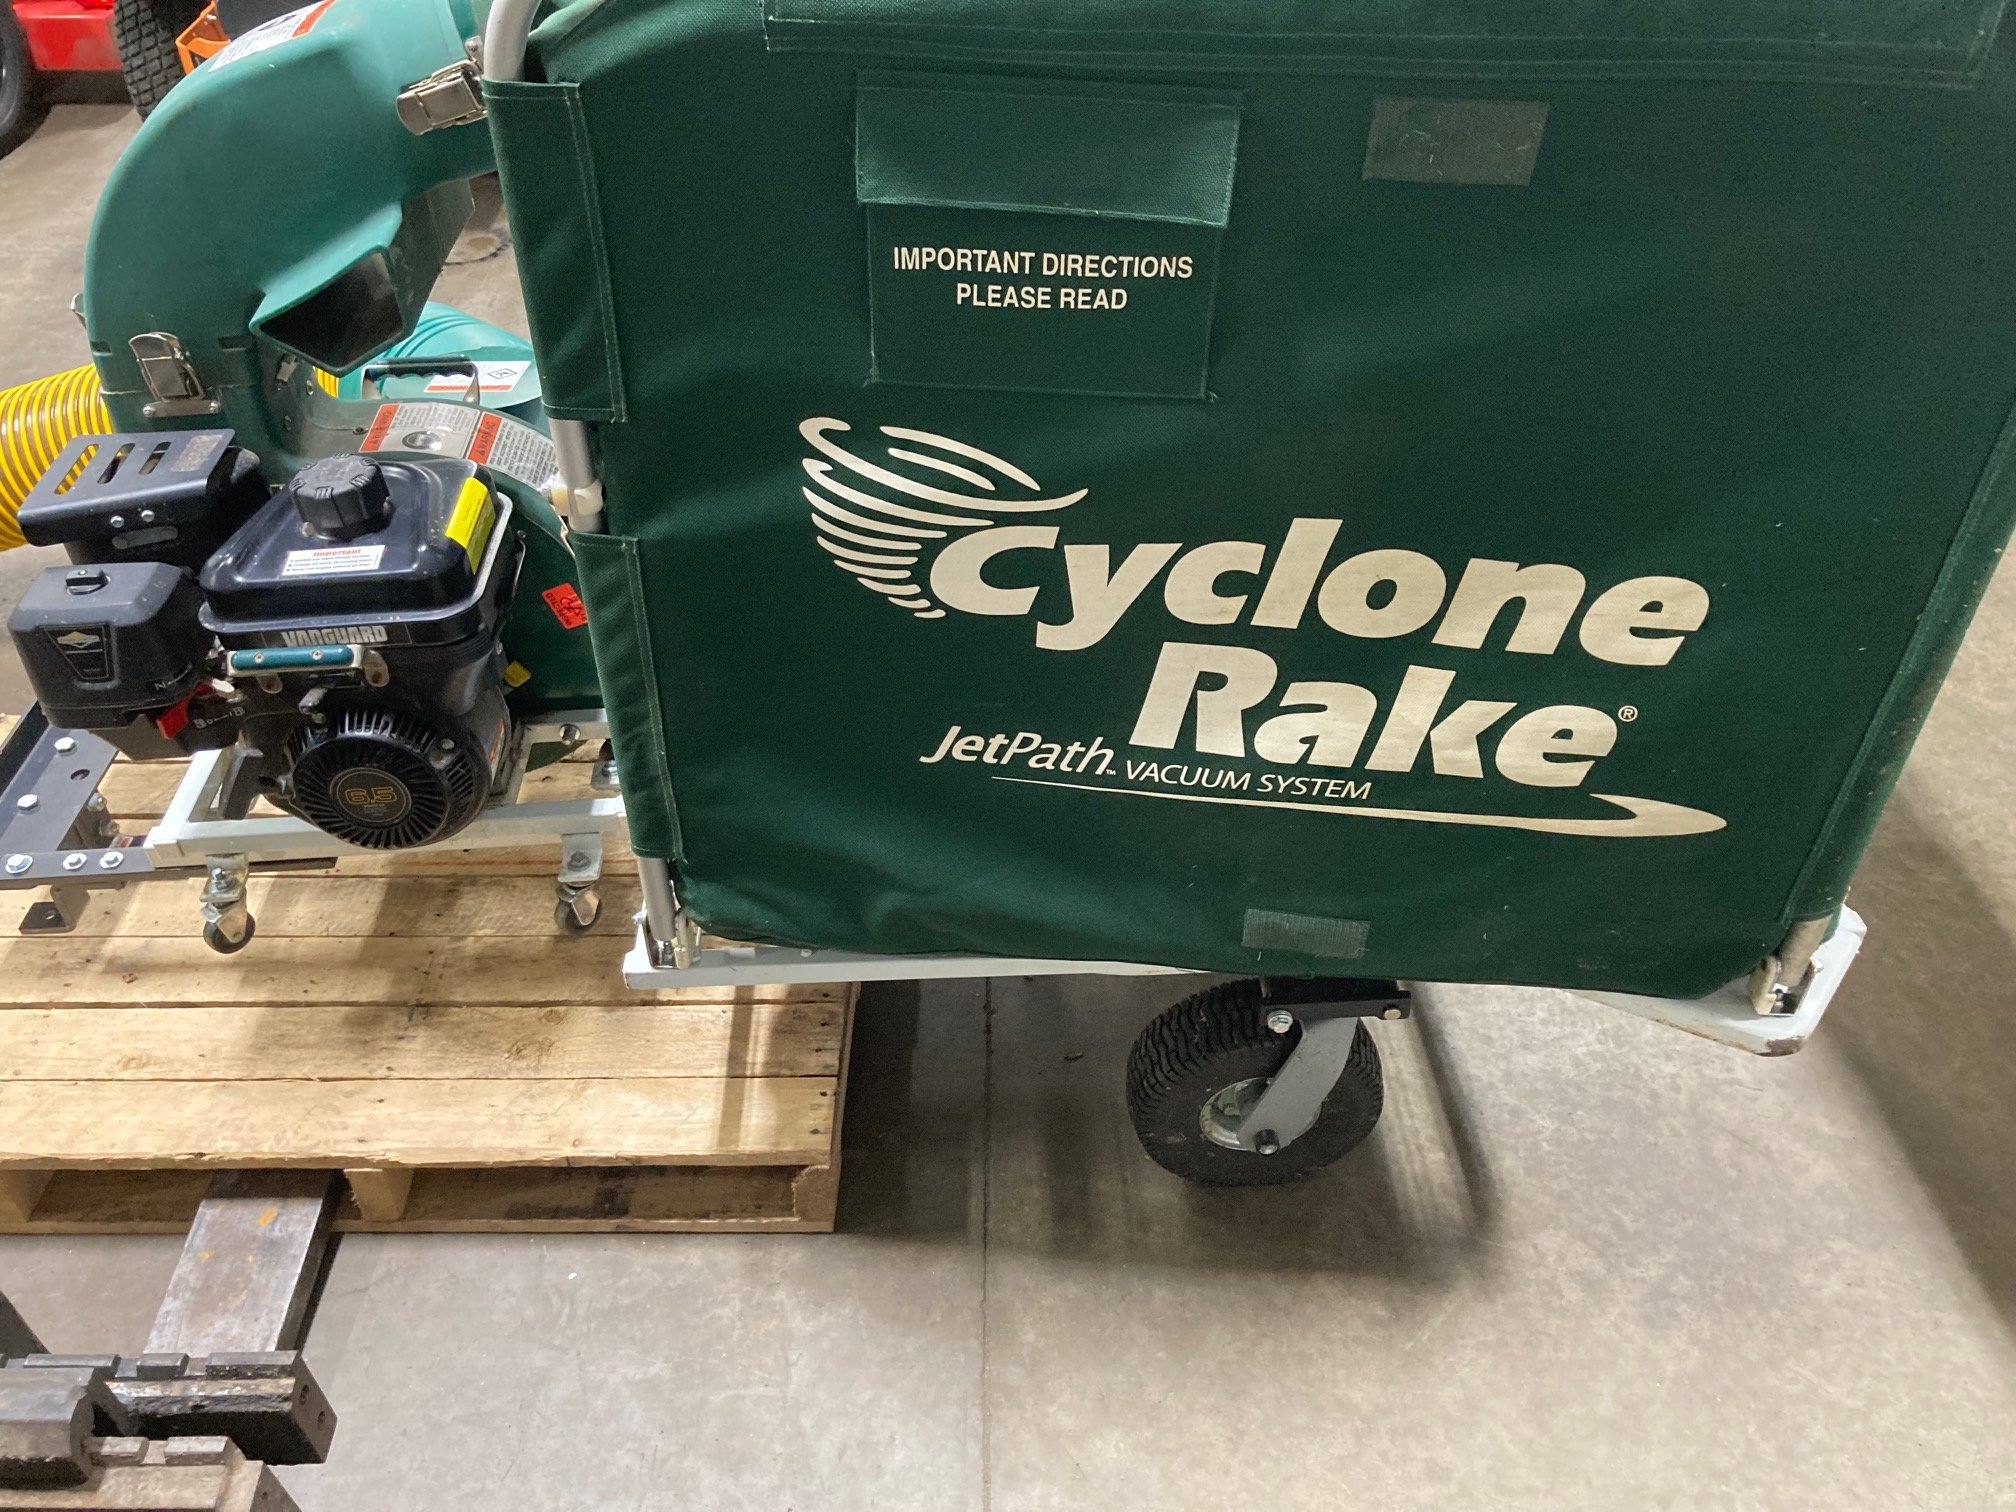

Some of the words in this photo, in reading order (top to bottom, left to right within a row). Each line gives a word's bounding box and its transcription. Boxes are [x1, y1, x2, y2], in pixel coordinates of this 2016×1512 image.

[893, 246, 1036, 275] IMPORTANT
[1042, 252, 1193, 279] DIRECTIONS
[956, 282, 1052, 309] PLEASE
[1059, 287, 1128, 310] READ
[929, 517, 1710, 666] Cyclone
[281, 625, 388, 647] VANGUARD
[1129, 641, 1618, 788] Rake
[919, 725, 1115, 776] JetPath
[1126, 759, 1252, 791] VACUUM
[1256, 774, 1372, 800] SYSTEM
